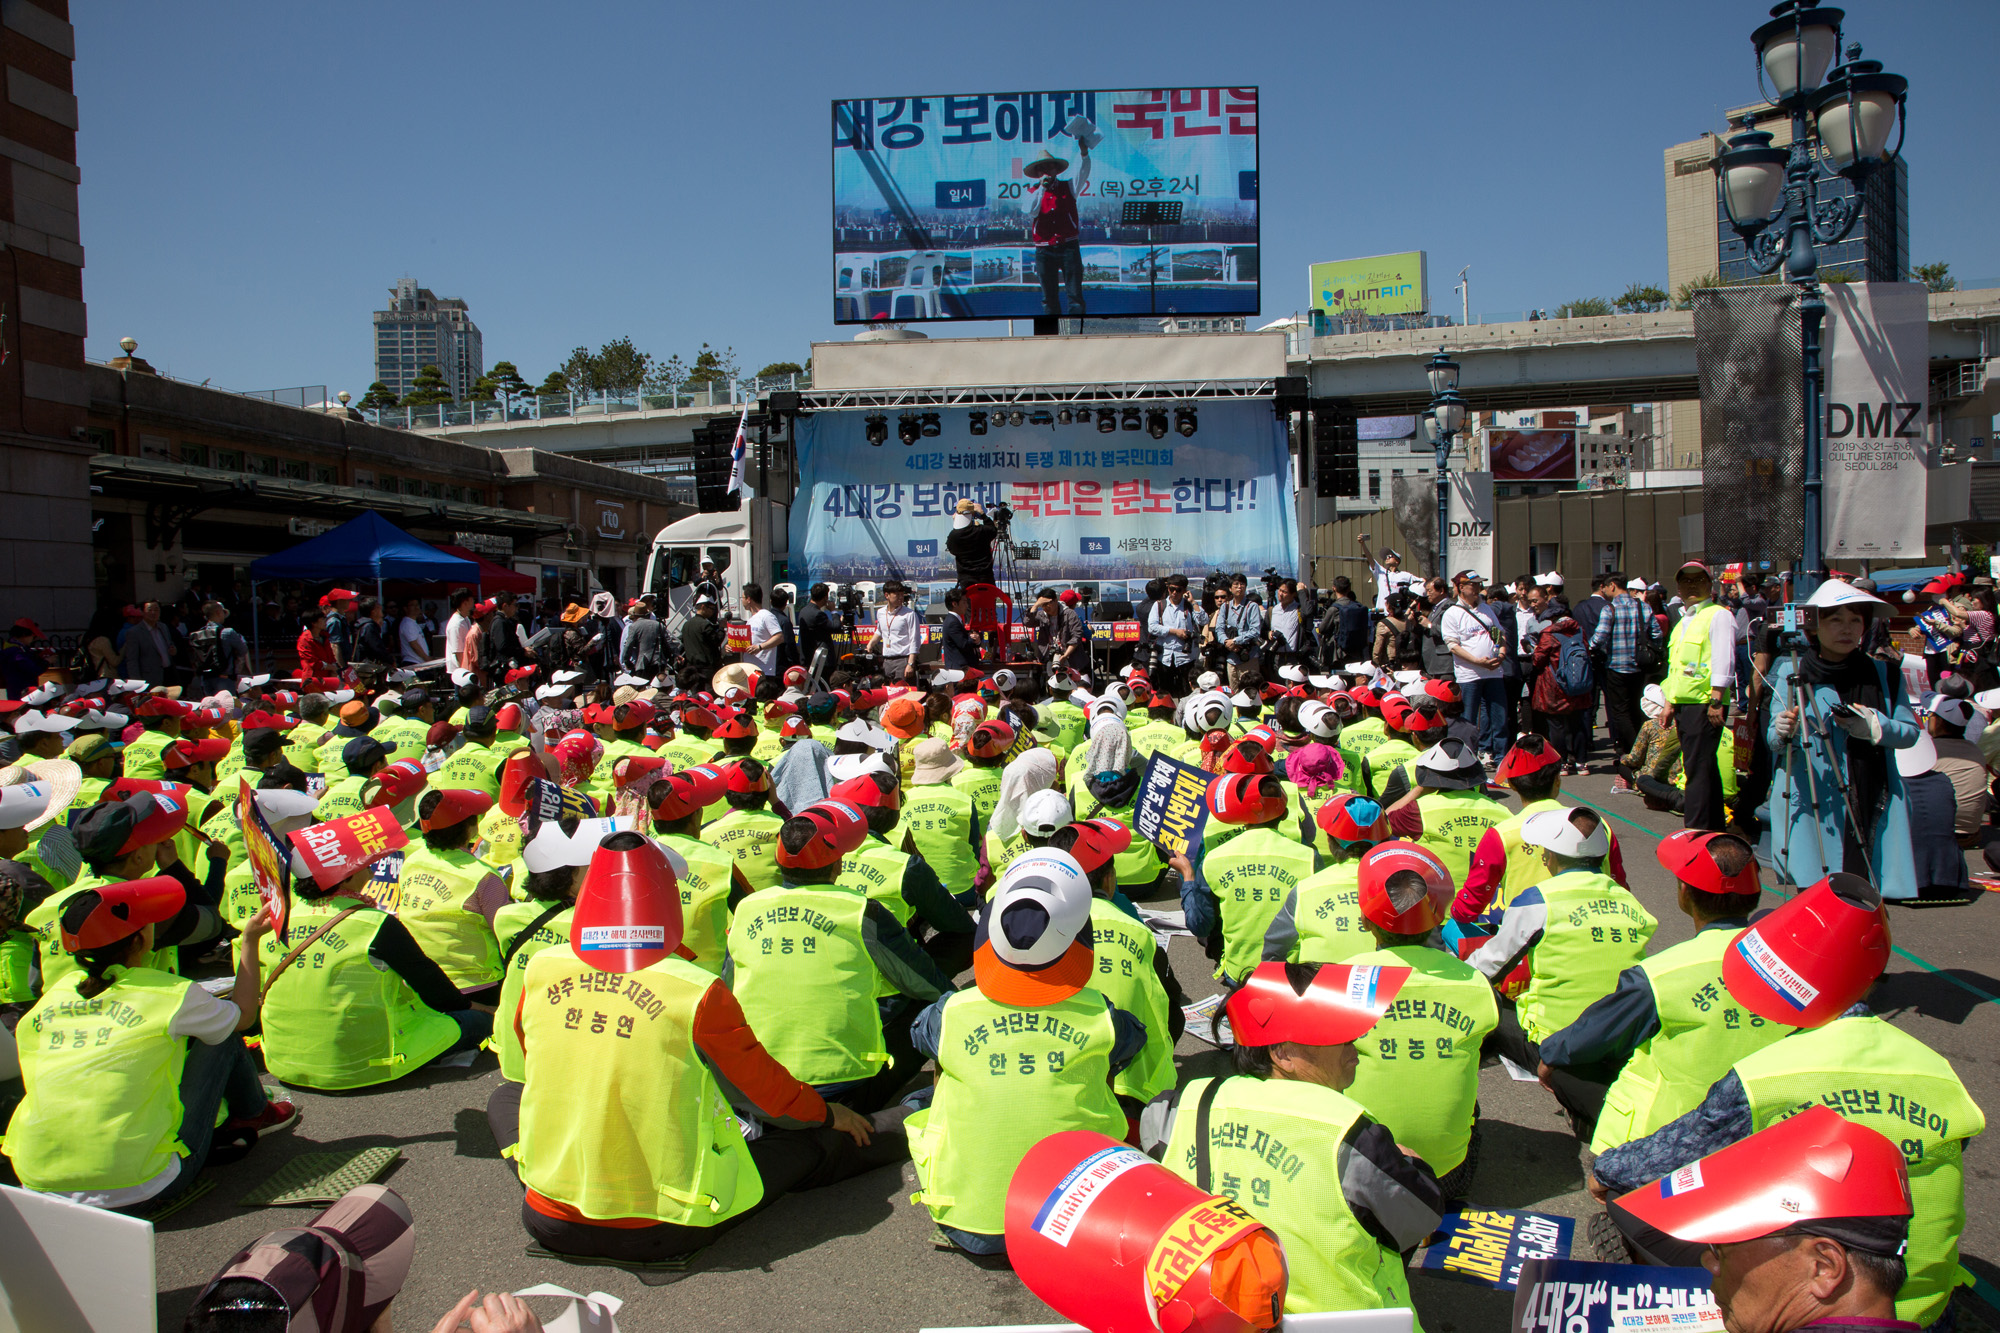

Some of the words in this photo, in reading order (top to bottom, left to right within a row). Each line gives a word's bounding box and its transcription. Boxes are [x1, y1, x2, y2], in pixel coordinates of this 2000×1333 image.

[948, 187, 973, 202] 일시
[1128, 178, 1160, 199] 오후
[1169, 175, 1201, 197] 2시
[1826, 402, 1922, 438] DMZ
[905, 452, 945, 471] 4대강
[948, 451, 1020, 471] 보해체저지
[1024, 450, 1054, 469] 투쟁
[1058, 449, 1097, 468] 제1차
[1101, 448, 1174, 468] 범국민대회
[1828, 452, 1874, 462] CULTURE
[1875, 451, 1916, 461] STATION
[1844, 462, 1879, 472] SEOUL
[1880, 462, 1898, 471] 284
[823, 481, 906, 520] 4대강
[1010, 479, 1103, 518] 국민은
[1111, 477, 1258, 515] 분노한다!!
[602, 509, 619, 529] rto
[1448, 521, 1491, 537] DMZ
[915, 543, 930, 553] 일시
[1087, 541, 1103, 551] 장소
[1117, 537, 1149, 552] 서울역
[1150, 537, 1173, 552] 광장
[1158, 768, 1208, 857] 결사반대!
[1236, 863, 1267, 878] 낙단보
[1588, 899, 1618, 916] 낙단보
[611, 929, 627, 940] 해체
[630, 929, 663, 940] 결사반대!
[746, 915, 764, 941] 상주
[766, 906, 800, 925] 낙단보
[800, 908, 838, 937] 지킴이
[547, 976, 575, 1006] 상주
[579, 971, 624, 993] 낙단보
[622, 979, 667, 1021] 지킴이
[1690, 982, 1720, 1014] 상주
[60, 998, 104, 1017] 낙단보
[105, 1000, 148, 1029] 지킴이
[1429, 1001, 1477, 1037] 지킴이
[963, 1024, 991, 1057] 상주
[992, 1011, 1040, 1036] 낙단보
[1042, 1015, 1091, 1051] 지킴이
[1820, 1088, 1881, 1116] 낙단보
[1887, 1092, 1950, 1140] 지킴이
[1250, 1128, 1306, 1183] 지킴이
[1443, 1207, 1516, 1283] 결사반대!
